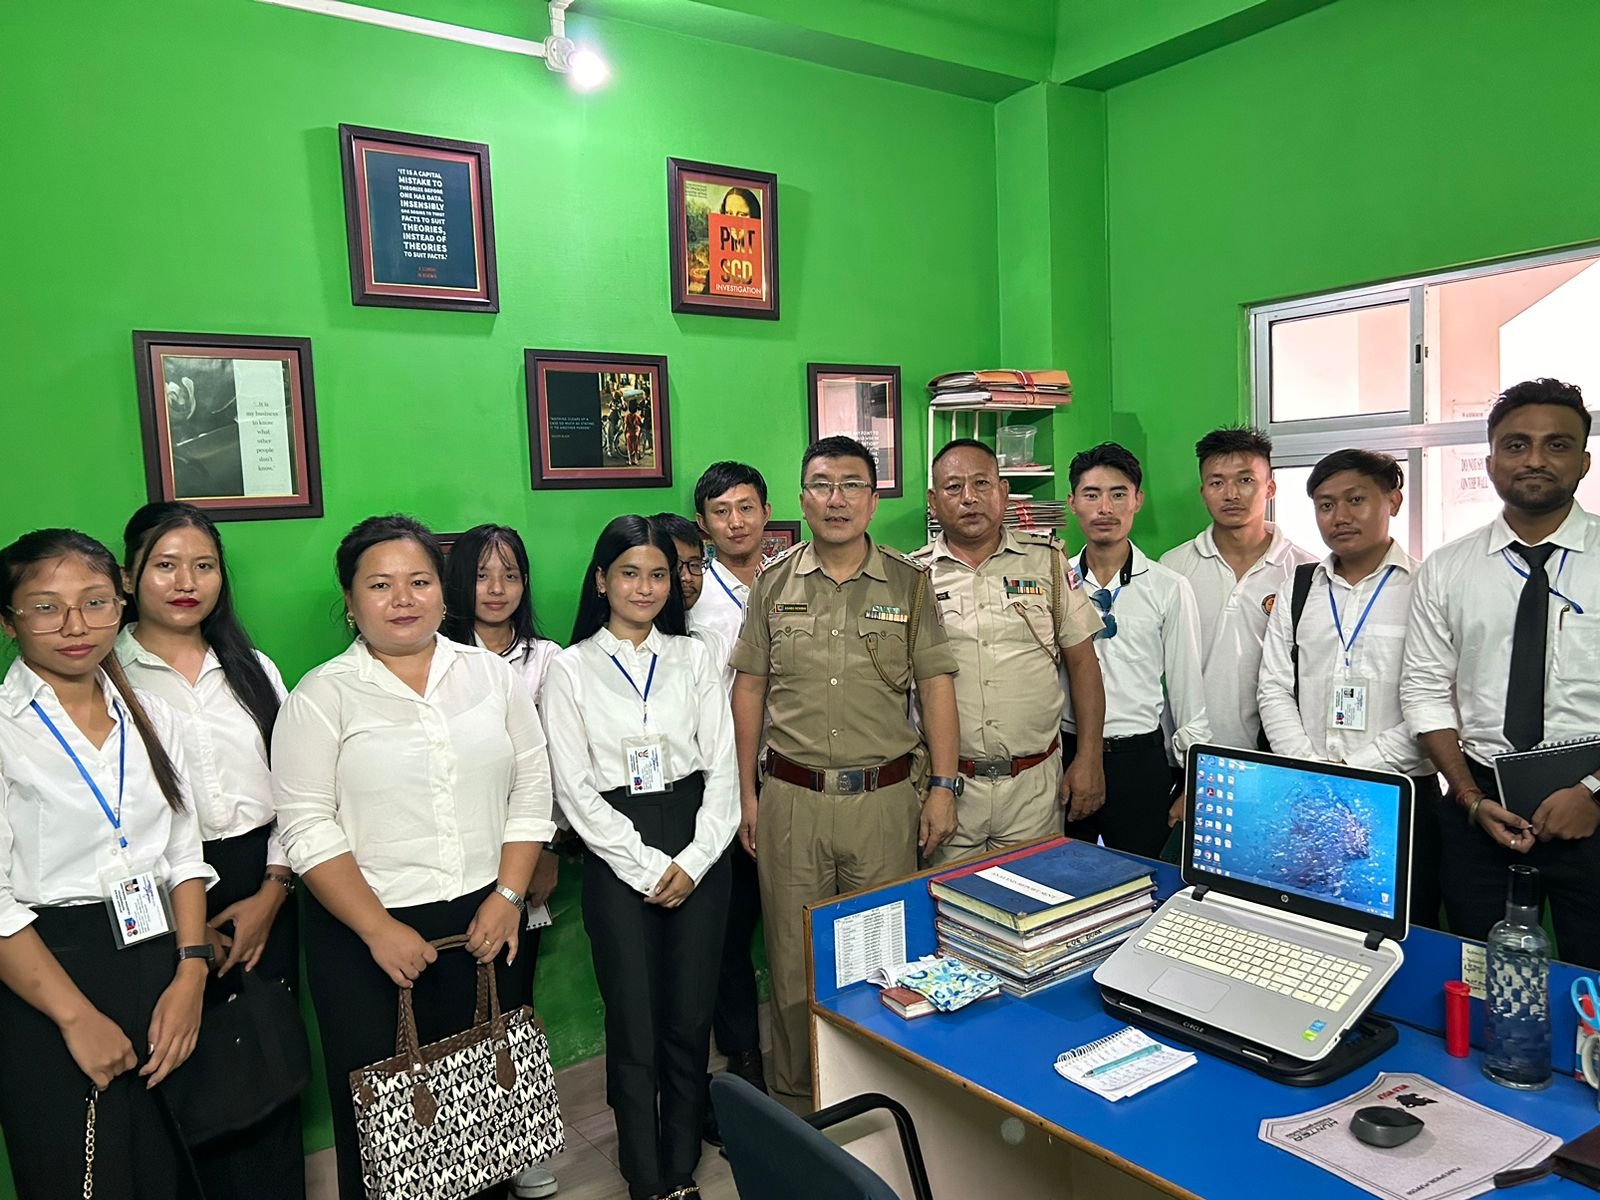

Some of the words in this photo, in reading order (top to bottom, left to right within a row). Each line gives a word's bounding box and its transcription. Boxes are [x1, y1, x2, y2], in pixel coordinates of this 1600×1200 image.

[418, 171, 442, 179] CAPITAL
[398, 176, 431, 187] MISTAKE
[432, 180, 443, 188] TO
[400, 200, 444, 210] INSENSIBLY
[402, 232, 435, 242] INSTEAD
[720, 226, 756, 254] PMT
[403, 242, 447, 253] THEORIES
[720, 258, 753, 285] SCD
[716, 284, 761, 294] INVESTIGATION
[1183, 1022, 1204, 1033] CIRCLE
[1293, 1121, 1339, 1142] HUNTER
